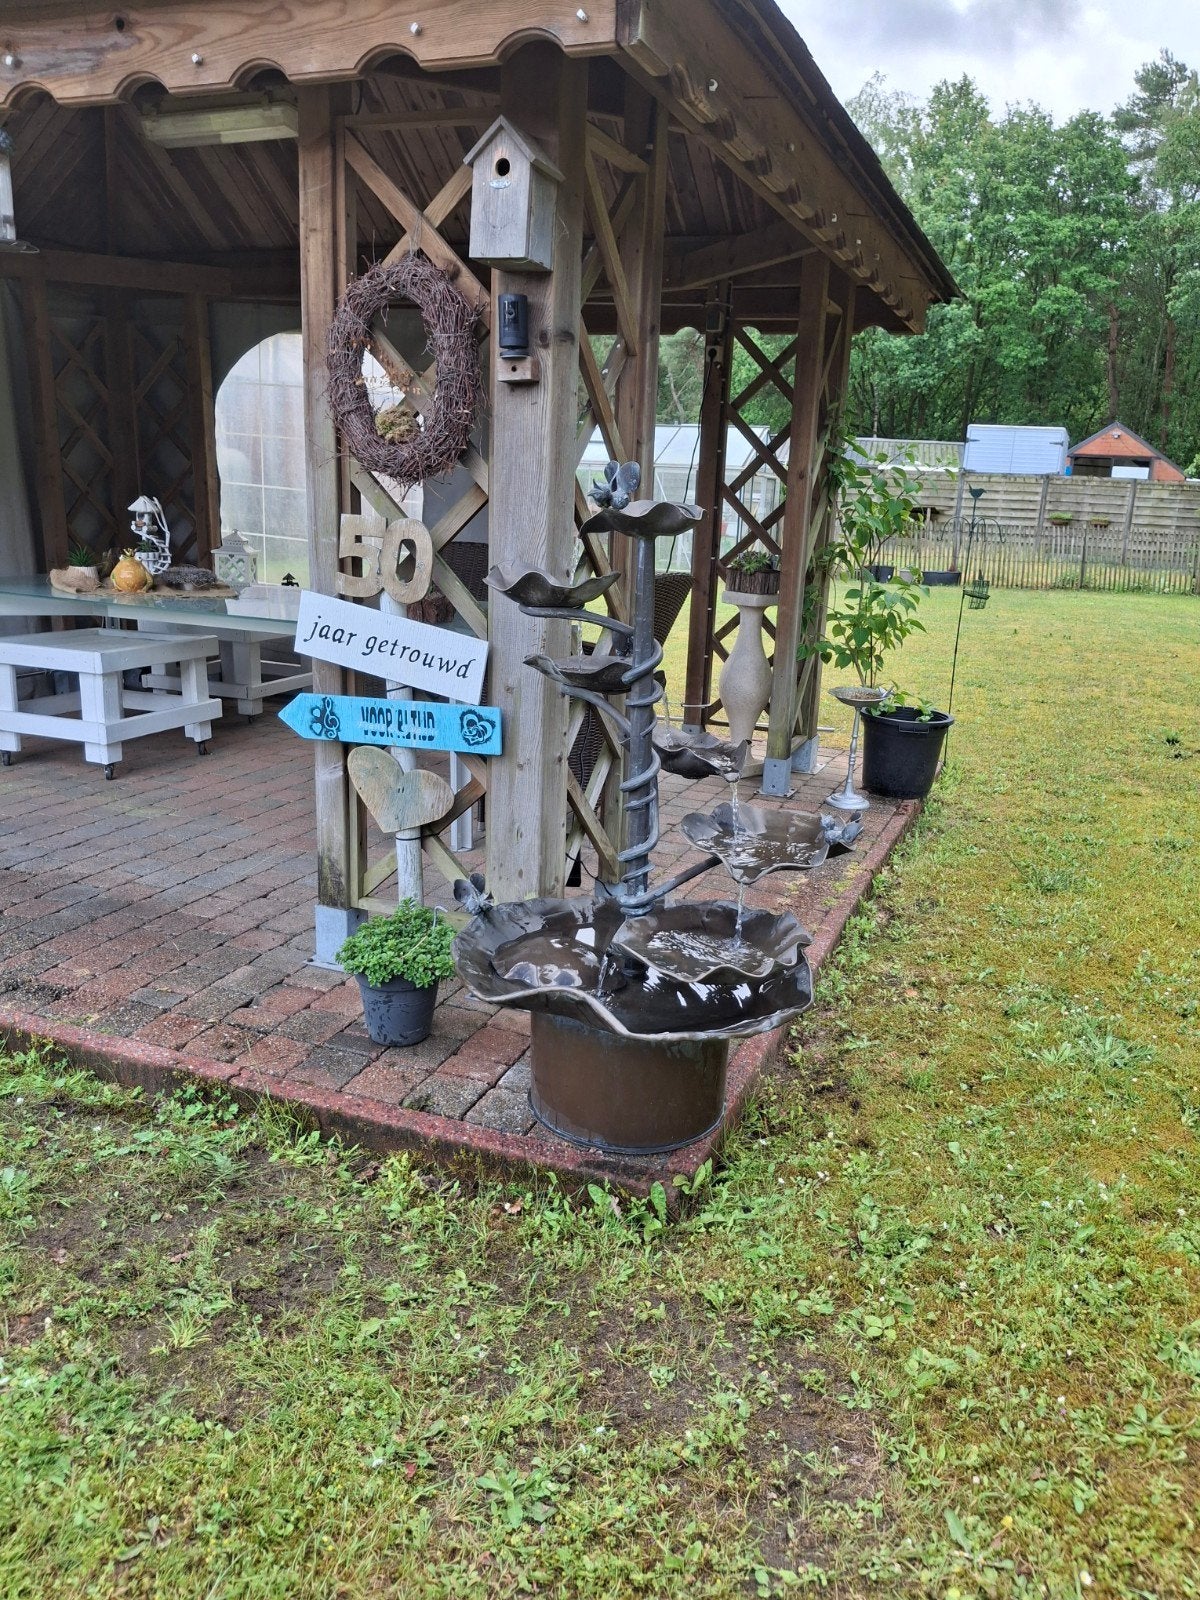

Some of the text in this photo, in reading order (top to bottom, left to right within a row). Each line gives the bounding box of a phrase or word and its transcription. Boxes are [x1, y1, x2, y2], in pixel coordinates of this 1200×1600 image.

[337, 513, 433, 604] 50
[303, 615, 476, 679] jaar getrouwd
